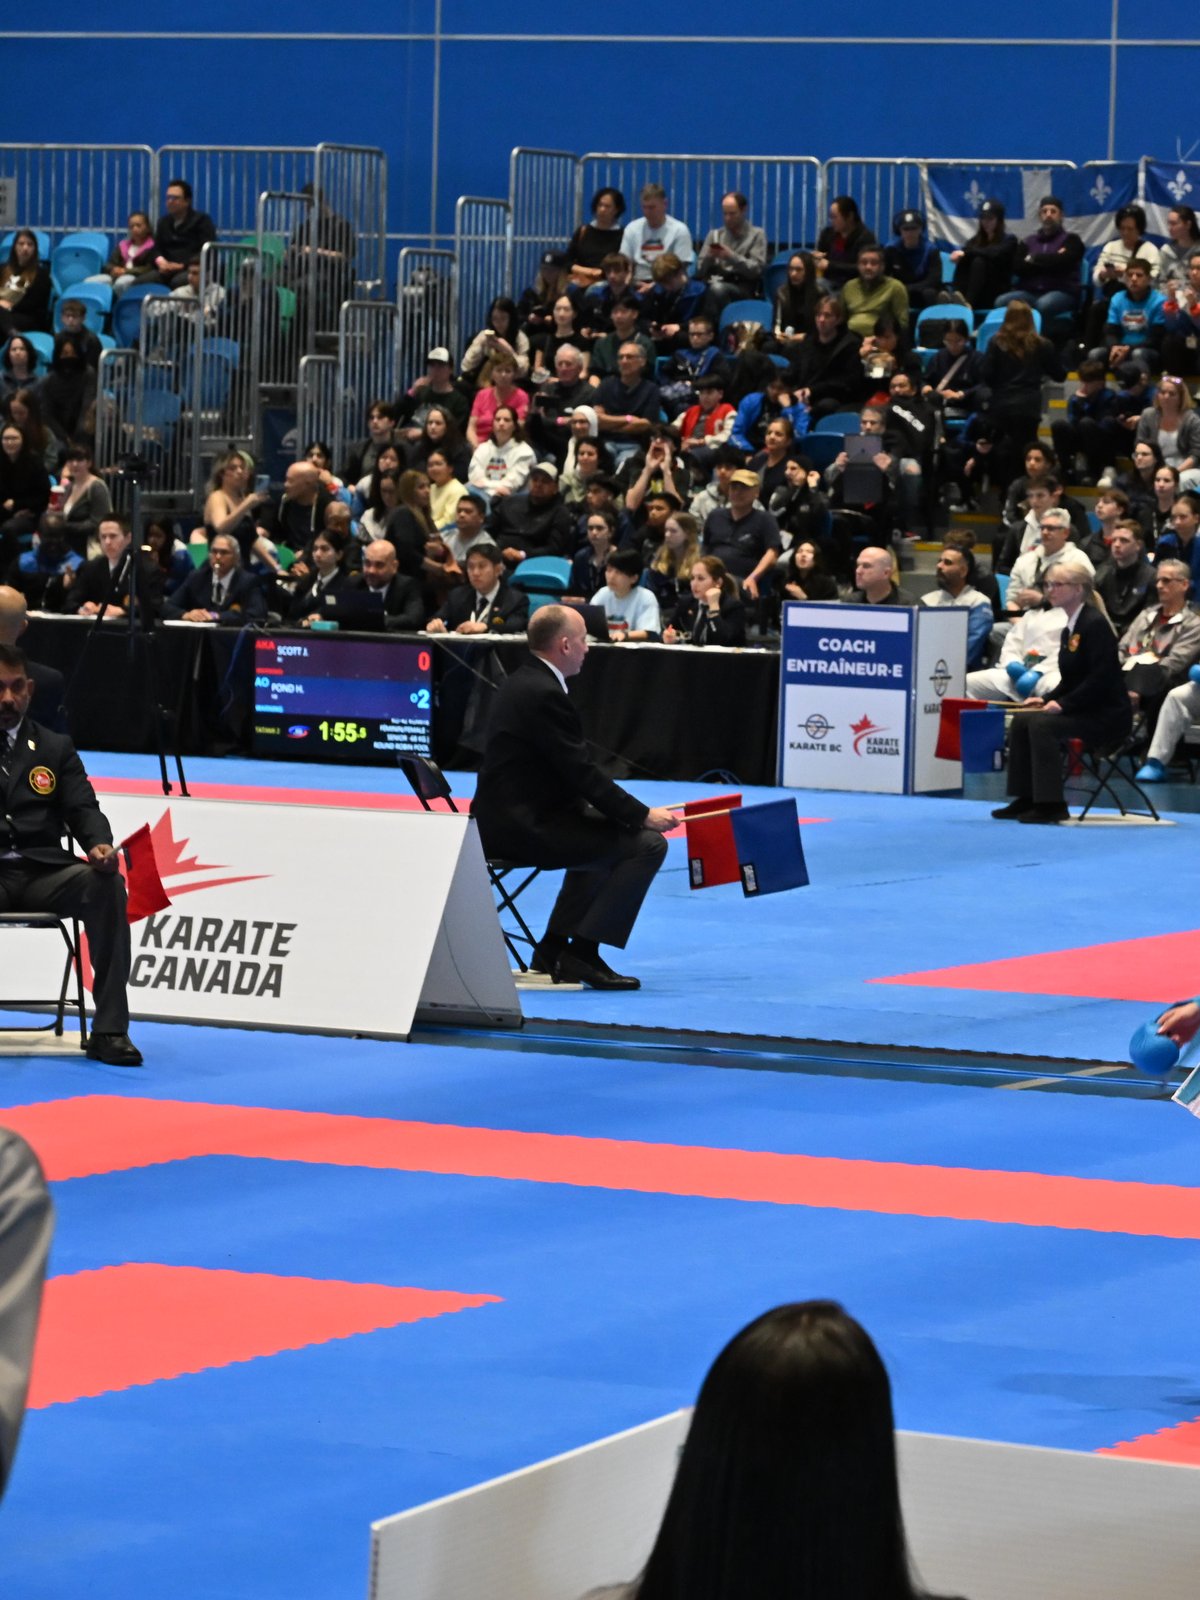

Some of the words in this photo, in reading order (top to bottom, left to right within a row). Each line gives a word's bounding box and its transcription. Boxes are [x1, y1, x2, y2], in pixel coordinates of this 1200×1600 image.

[818, 637, 876, 653] COACH
[418, 651, 431, 671] 0
[254, 676, 270, 688] AO
[271, 682, 295, 694] POND
[417, 689, 430, 709] 2
[789, 741, 827, 752] KARATE
[829, 743, 842, 753] BC
[866, 737, 899, 747] KARATE
[866, 745, 900, 756] CANADA
[140, 914, 298, 958] KARATE
[128, 953, 283, 998] CANADA
